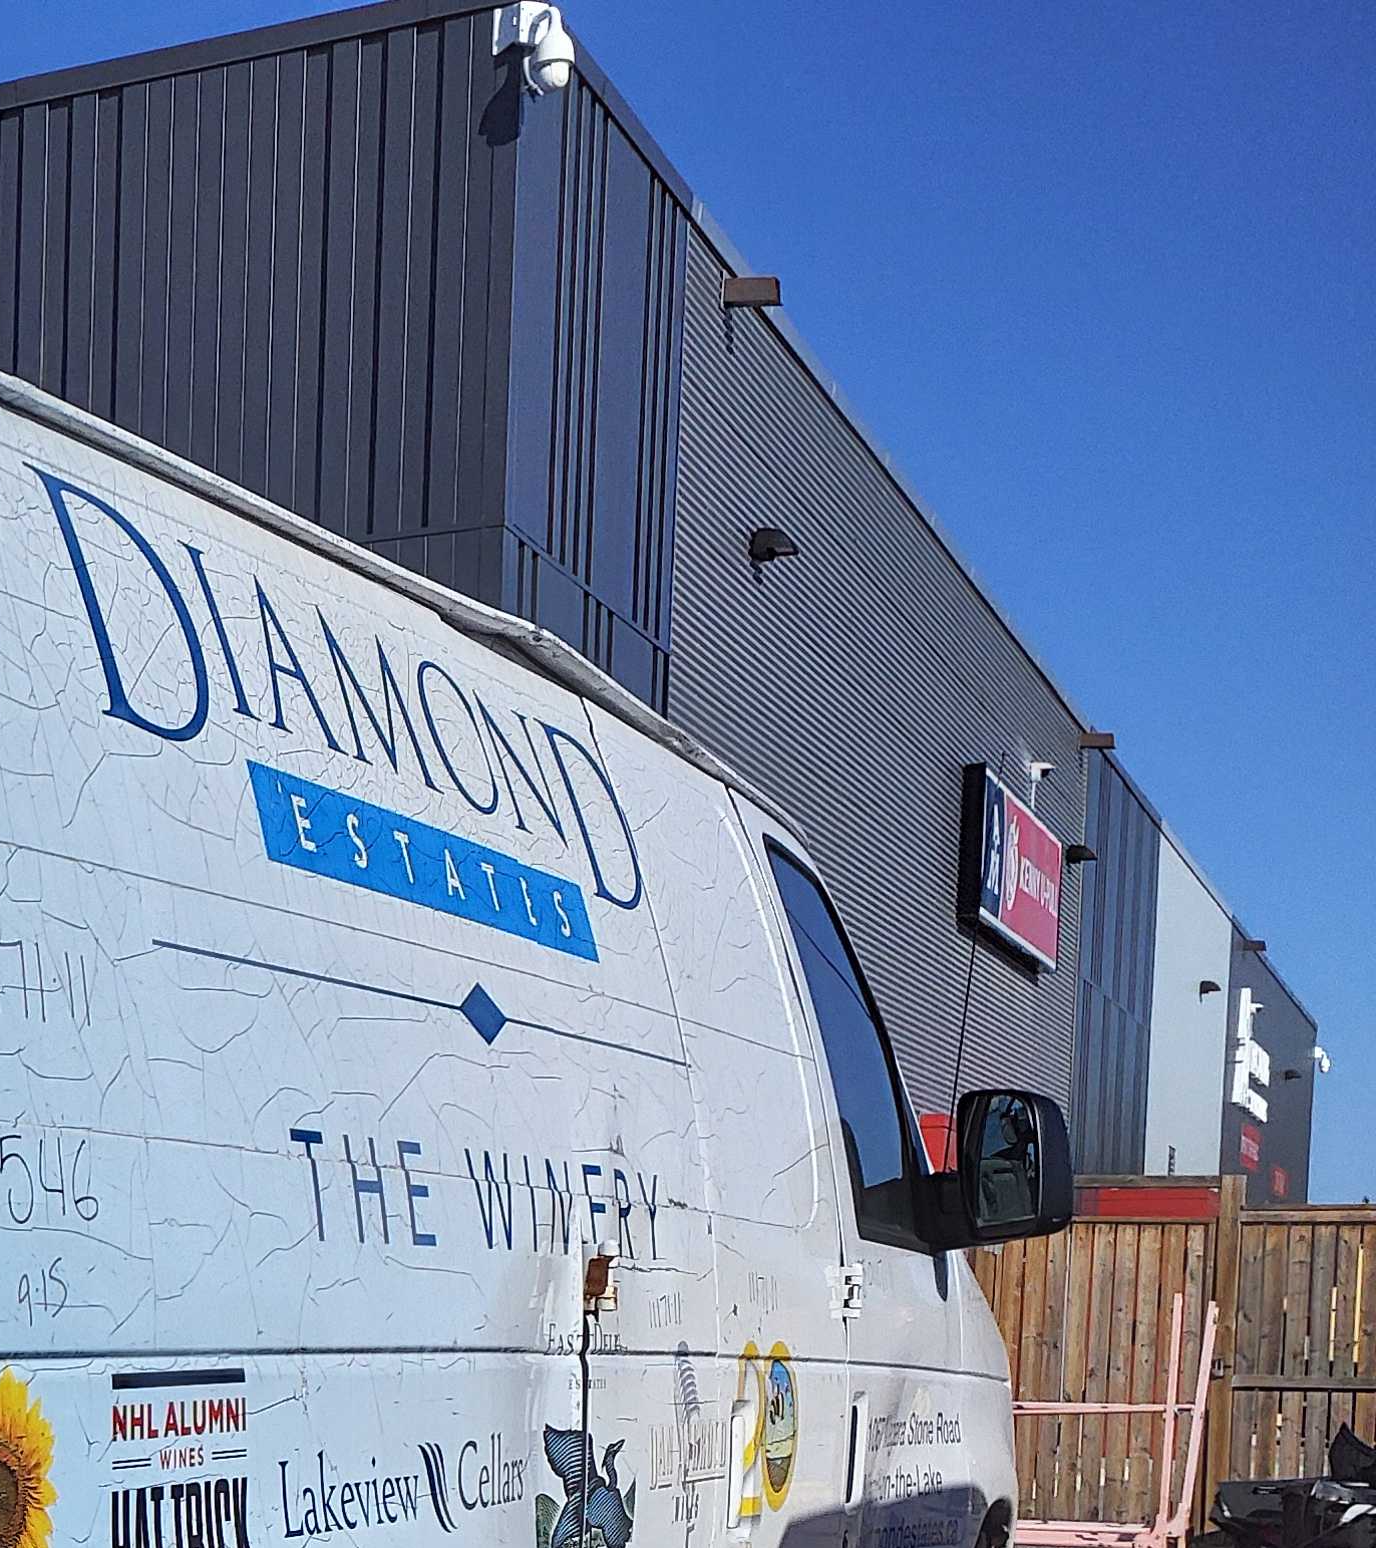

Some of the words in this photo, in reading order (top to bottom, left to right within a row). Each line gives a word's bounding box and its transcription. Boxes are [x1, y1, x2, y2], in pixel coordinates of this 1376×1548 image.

[23, 461, 643, 910] DIAMOND
[289, 1127, 437, 1247] THE
[464, 1147, 658, 1261] WINERY
[112, 1403, 159, 1442] NHL
[164, 1397, 247, 1437] ALUMNI
[936, 1411, 962, 1445] Road
[159, 1446, 205, 1470] WINES
[278, 1449, 420, 1538] Lakeview
[457, 1432, 524, 1510] Cellars
